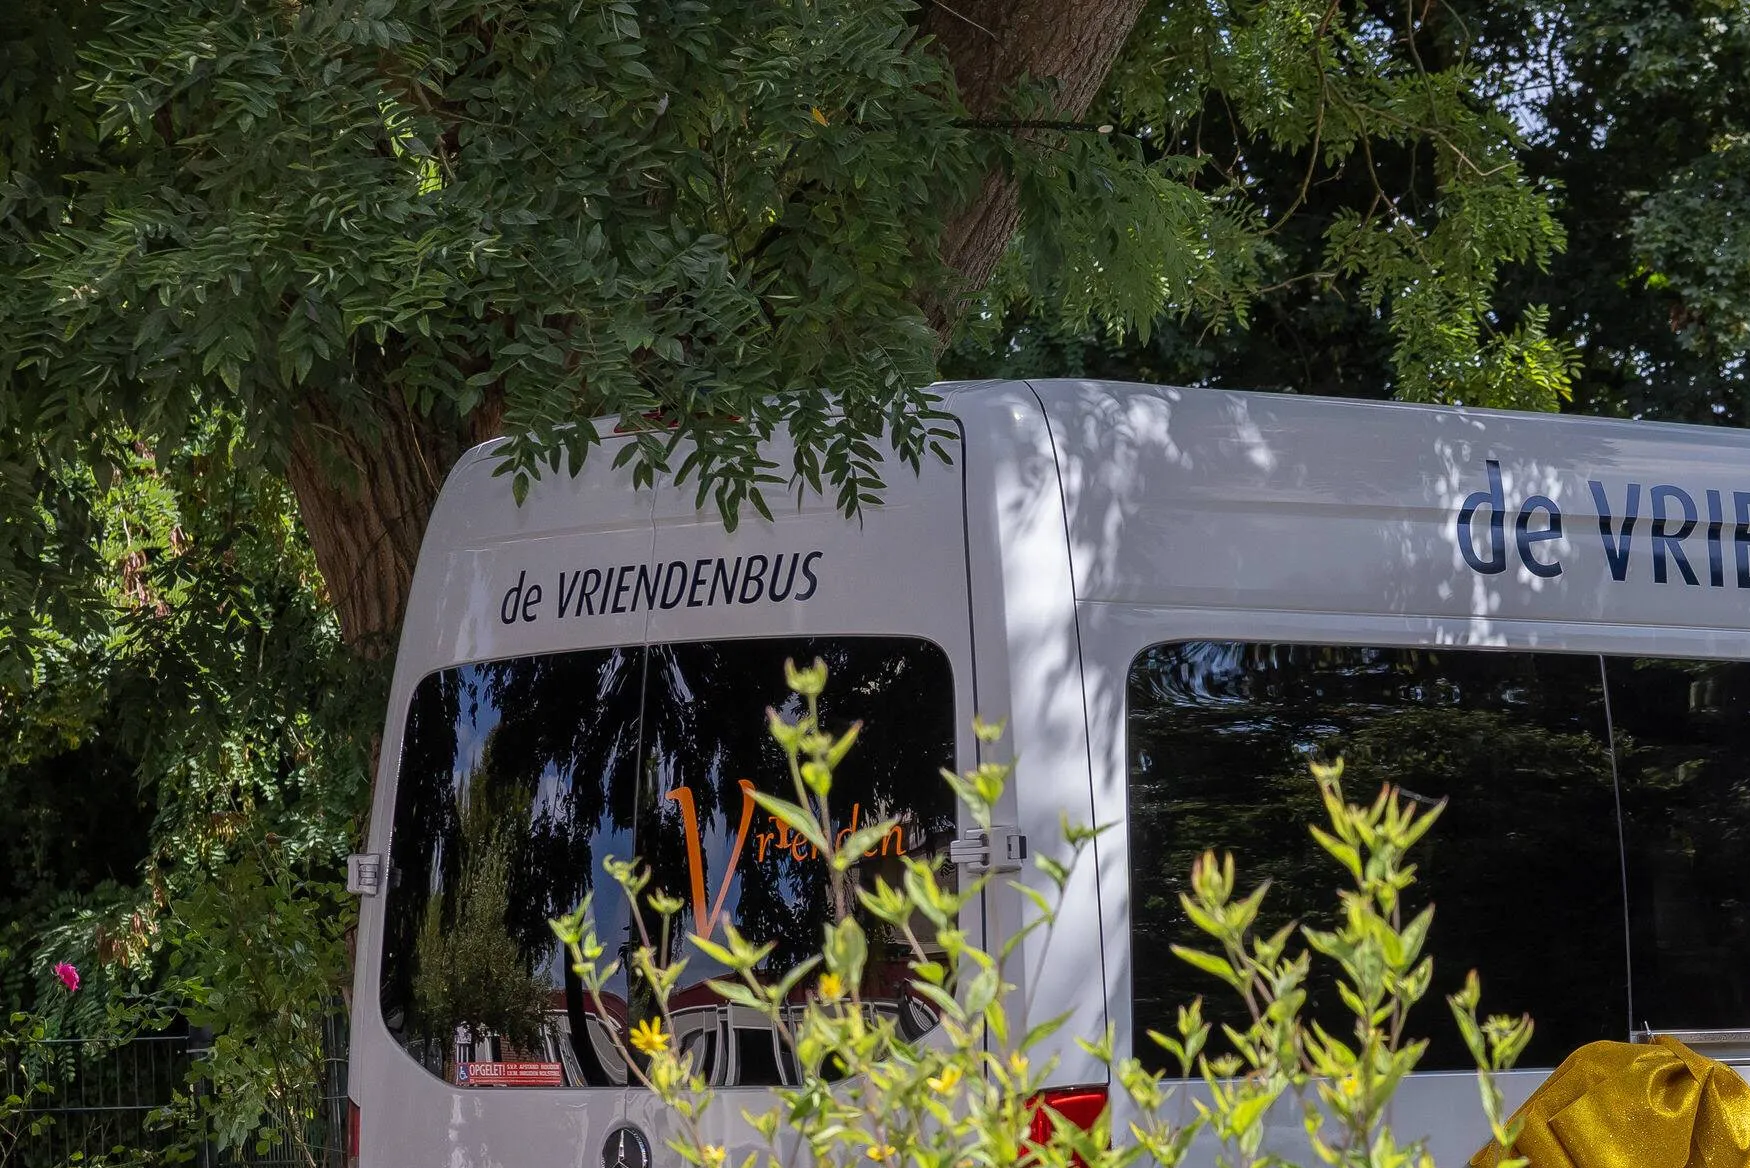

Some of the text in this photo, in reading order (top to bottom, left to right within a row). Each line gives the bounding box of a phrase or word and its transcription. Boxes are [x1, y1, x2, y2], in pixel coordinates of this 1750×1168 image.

[1457, 459, 1563, 578] de
[501, 551, 824, 625] de VRIENDENBUS
[469, 1064, 506, 1077] OPGELET!
